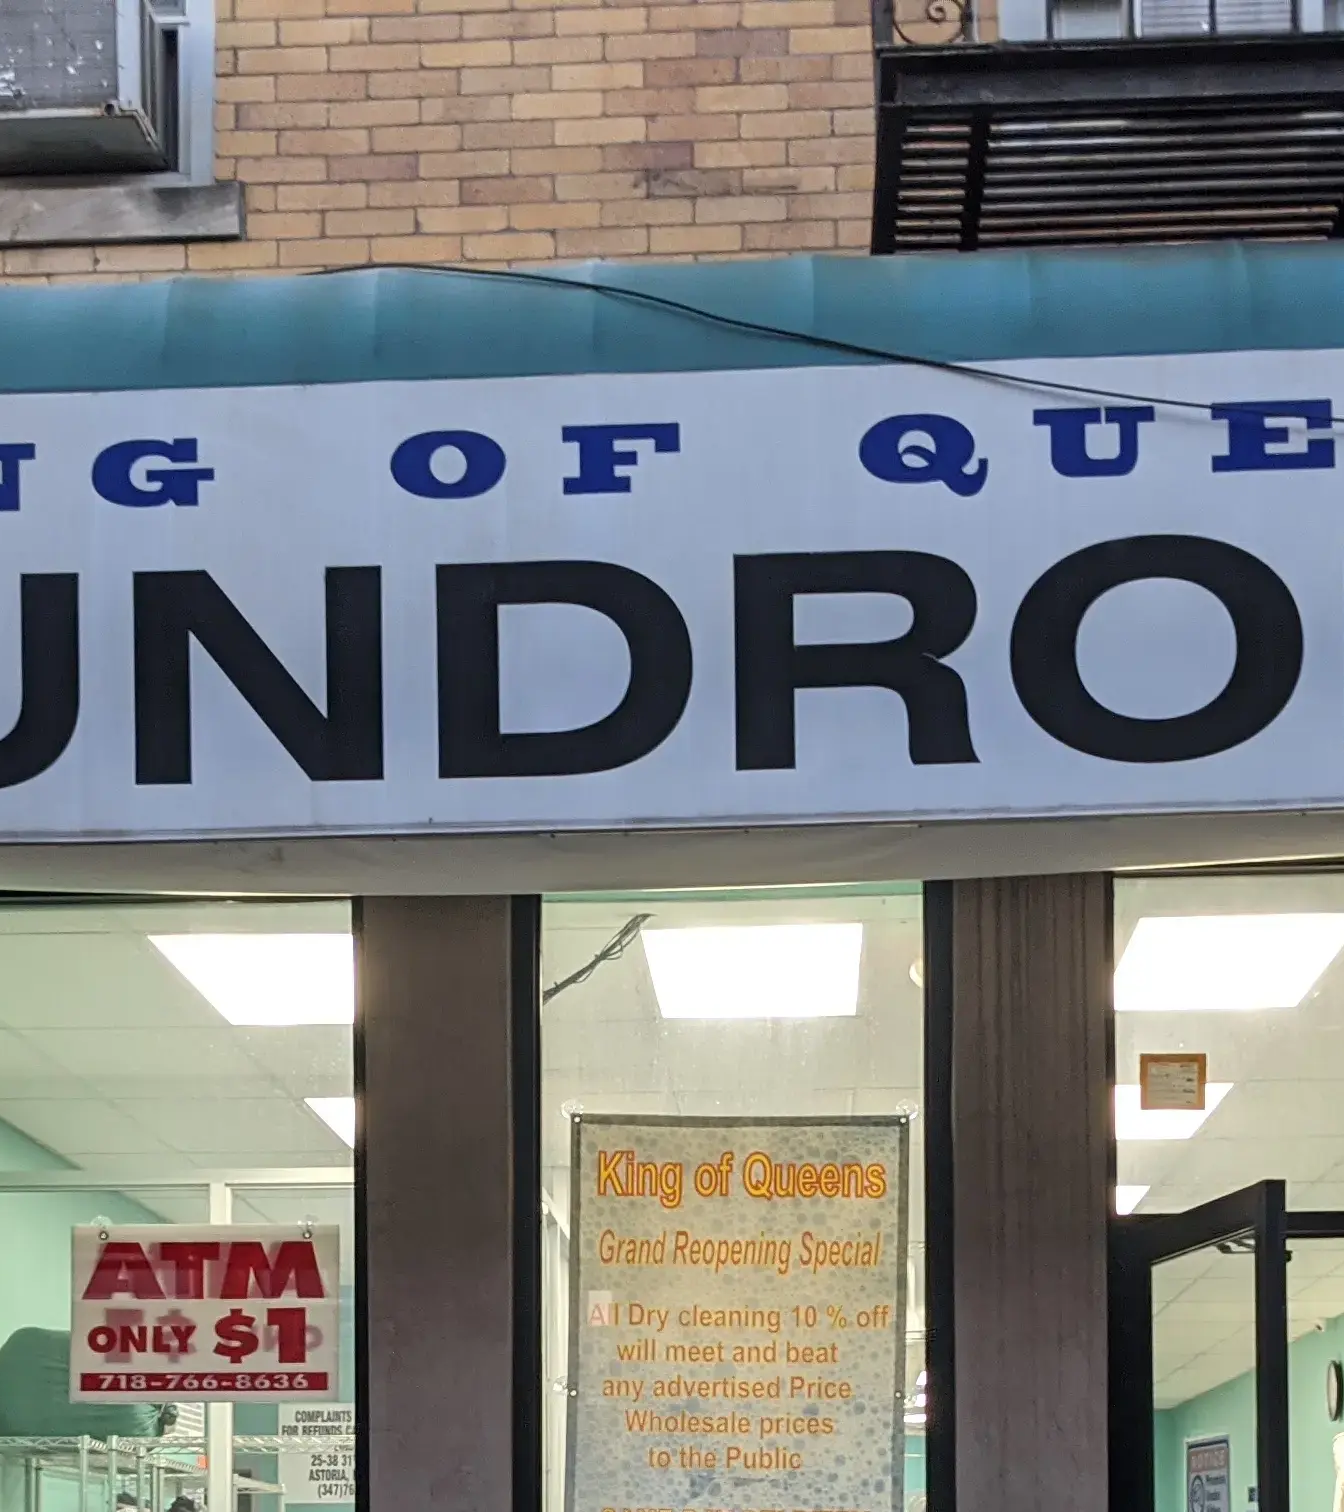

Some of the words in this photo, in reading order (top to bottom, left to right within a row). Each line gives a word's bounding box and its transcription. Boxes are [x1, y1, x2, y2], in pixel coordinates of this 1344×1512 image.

[389, 421, 682, 500] OF
[597, 1149, 684, 1209] King
[694, 1150, 735, 1198] of
[742, 1150, 888, 1200] Queens
[599, 1228, 667, 1267] Grand
[672, 1229, 792, 1275] Reopening
[798, 1230, 883, 1275] Special
[82, 1240, 325, 1300] ATM
[628, 1303, 669, 1332] Dry
[678, 1304, 781, 1333] cleaning
[791, 1305, 818, 1328] 10
[826, 1304, 848, 1329] %
[856, 1304, 891, 1330] off
[87, 1325, 197, 1353] ONLY
[212, 1307, 307, 1365] $1
[616, 1339, 656, 1362] will
[665, 1341, 724, 1363] meet
[732, 1341, 777, 1364] and
[786, 1341, 839, 1365] beat
[99, 1374, 309, 1391] 718-766-8636
[602, 1378, 644, 1402] any
[652, 1376, 781, 1400] advertised
[789, 1377, 853, 1400] Price
[281, 1425, 299, 1436] FOR
[302, 1425, 343, 1436] REFUNDS
[295, 1410, 353, 1423] COMPLAINTS
[625, 1409, 751, 1434] Wholesale
[758, 1412, 835, 1439] prices
[311, 1454, 339, 1467] 25-38
[648, 1448, 671, 1469] to
[678, 1446, 717, 1470] the
[726, 1446, 803, 1471] Public
